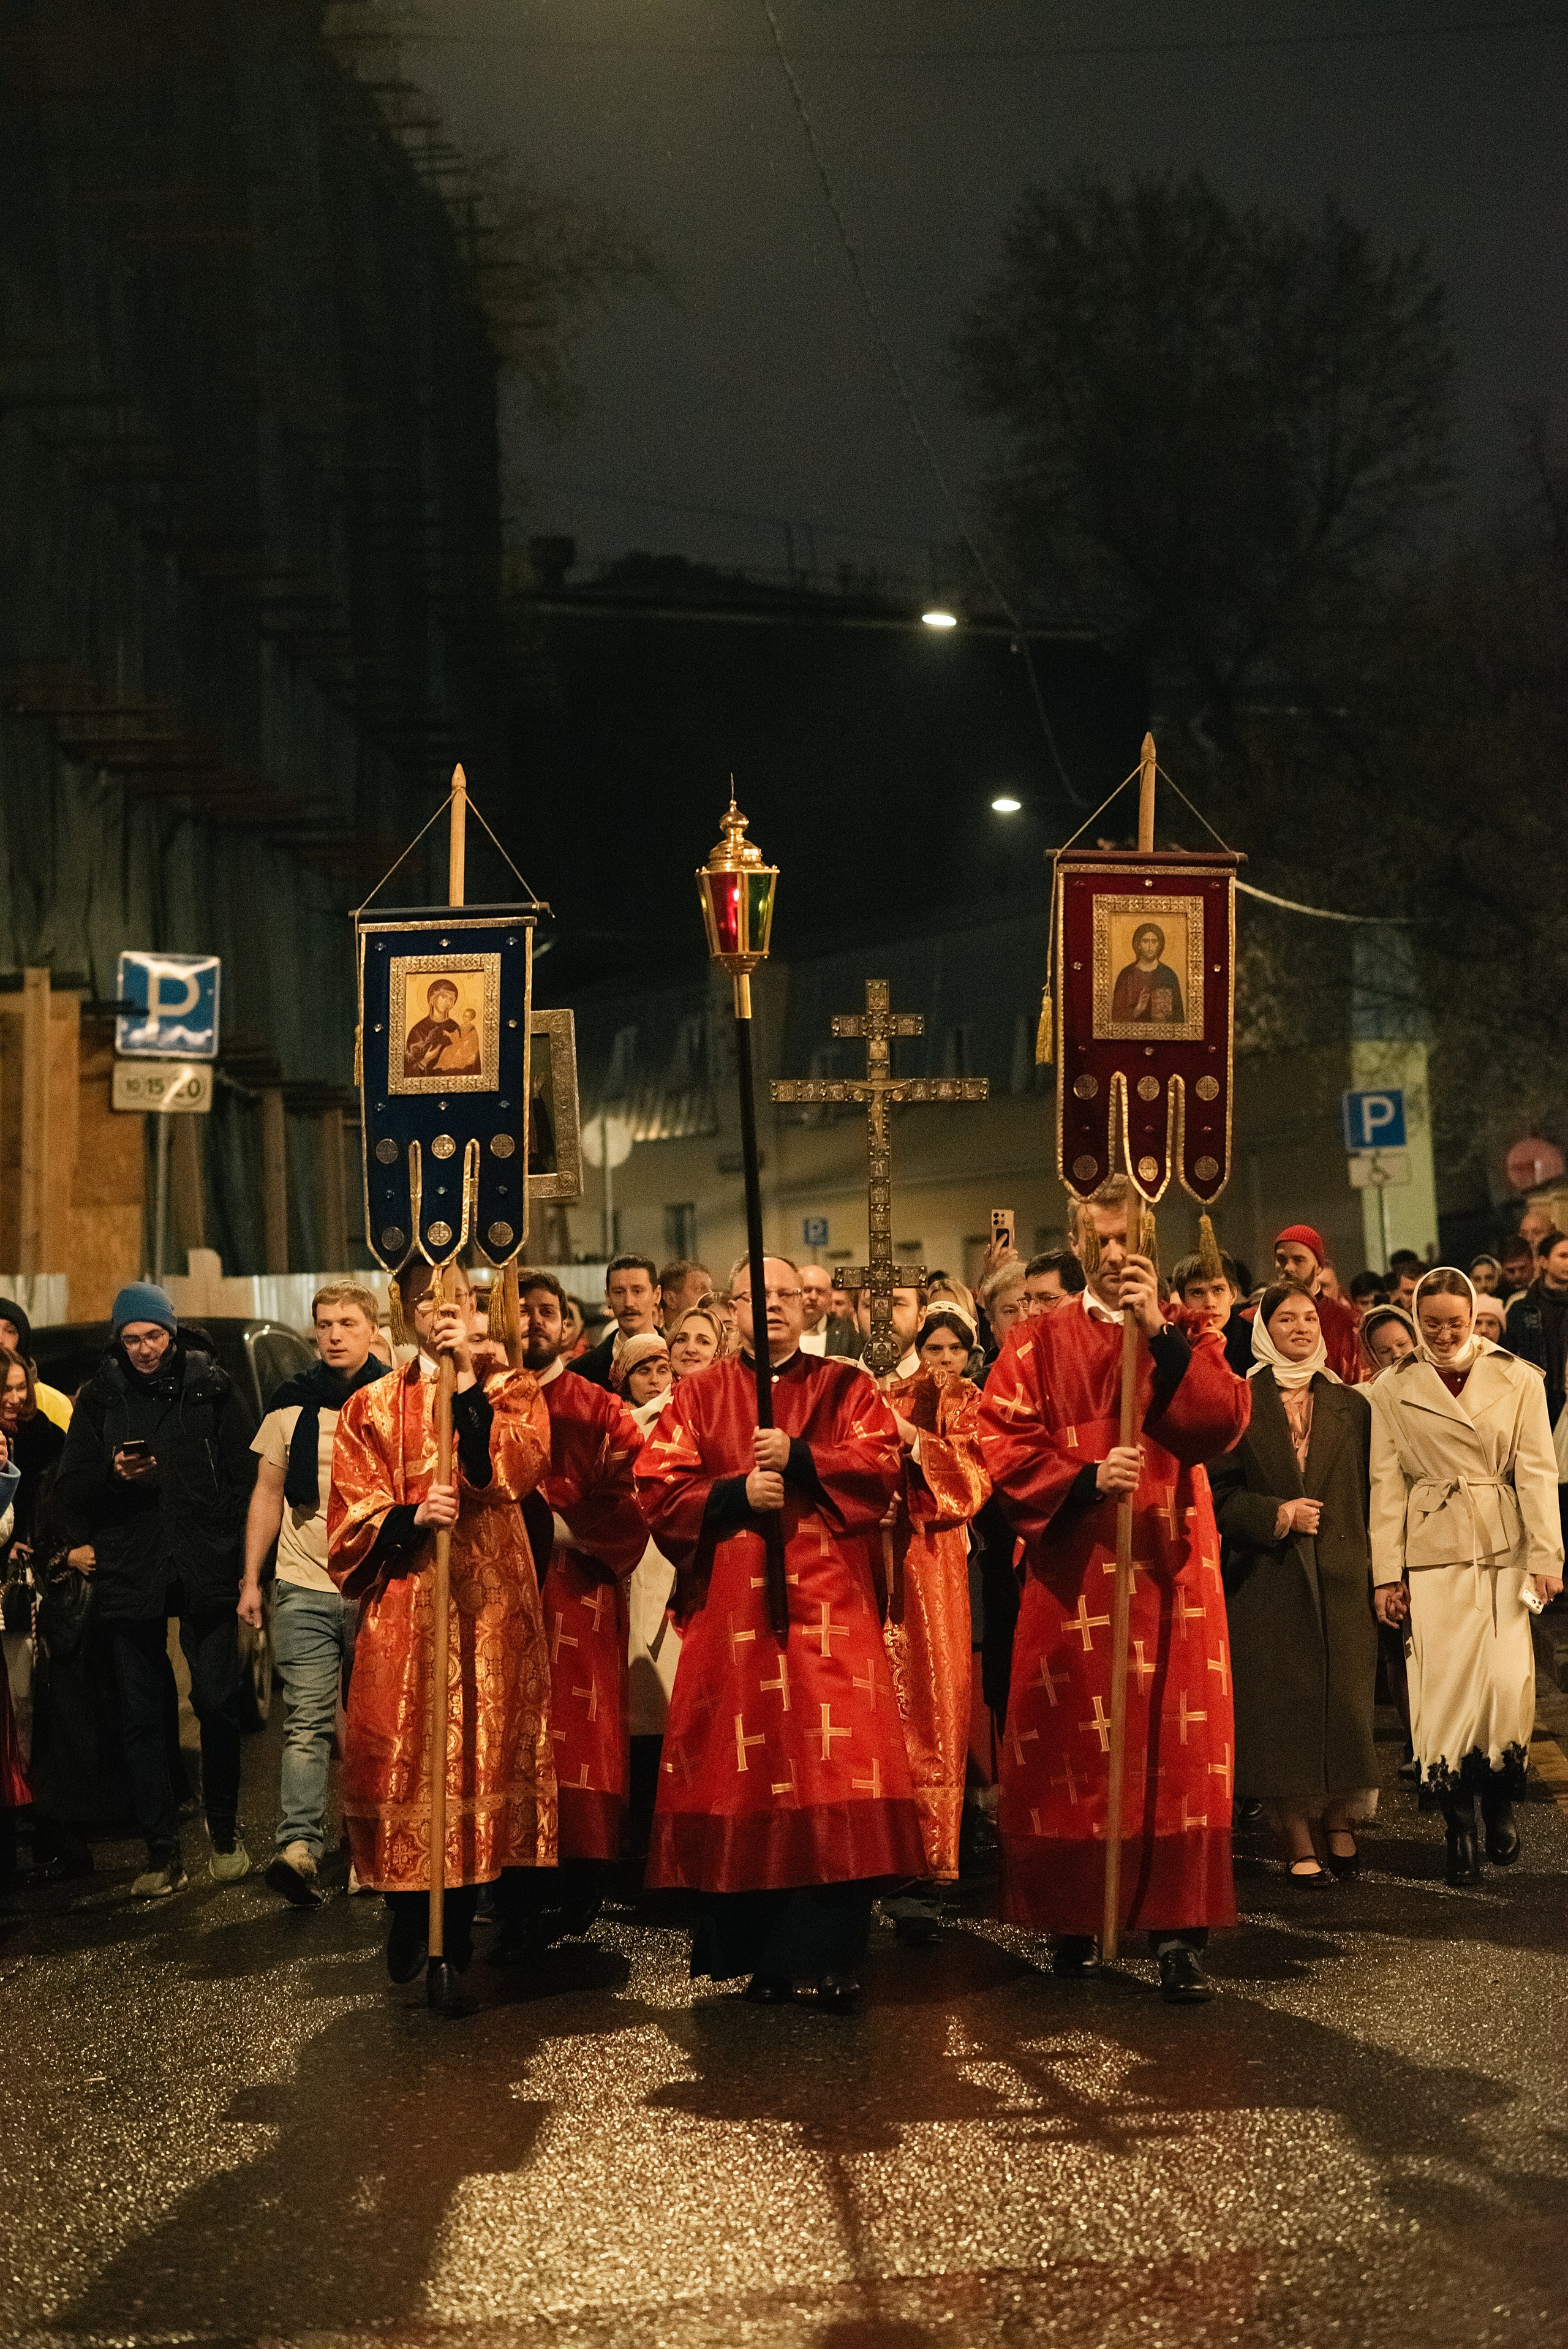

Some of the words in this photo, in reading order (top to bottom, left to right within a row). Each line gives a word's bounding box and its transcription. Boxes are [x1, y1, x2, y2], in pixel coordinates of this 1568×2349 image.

[147, 962, 200, 1035] P
[148, 1077, 165, 1095] 15
[1361, 1095, 1396, 1144] P
